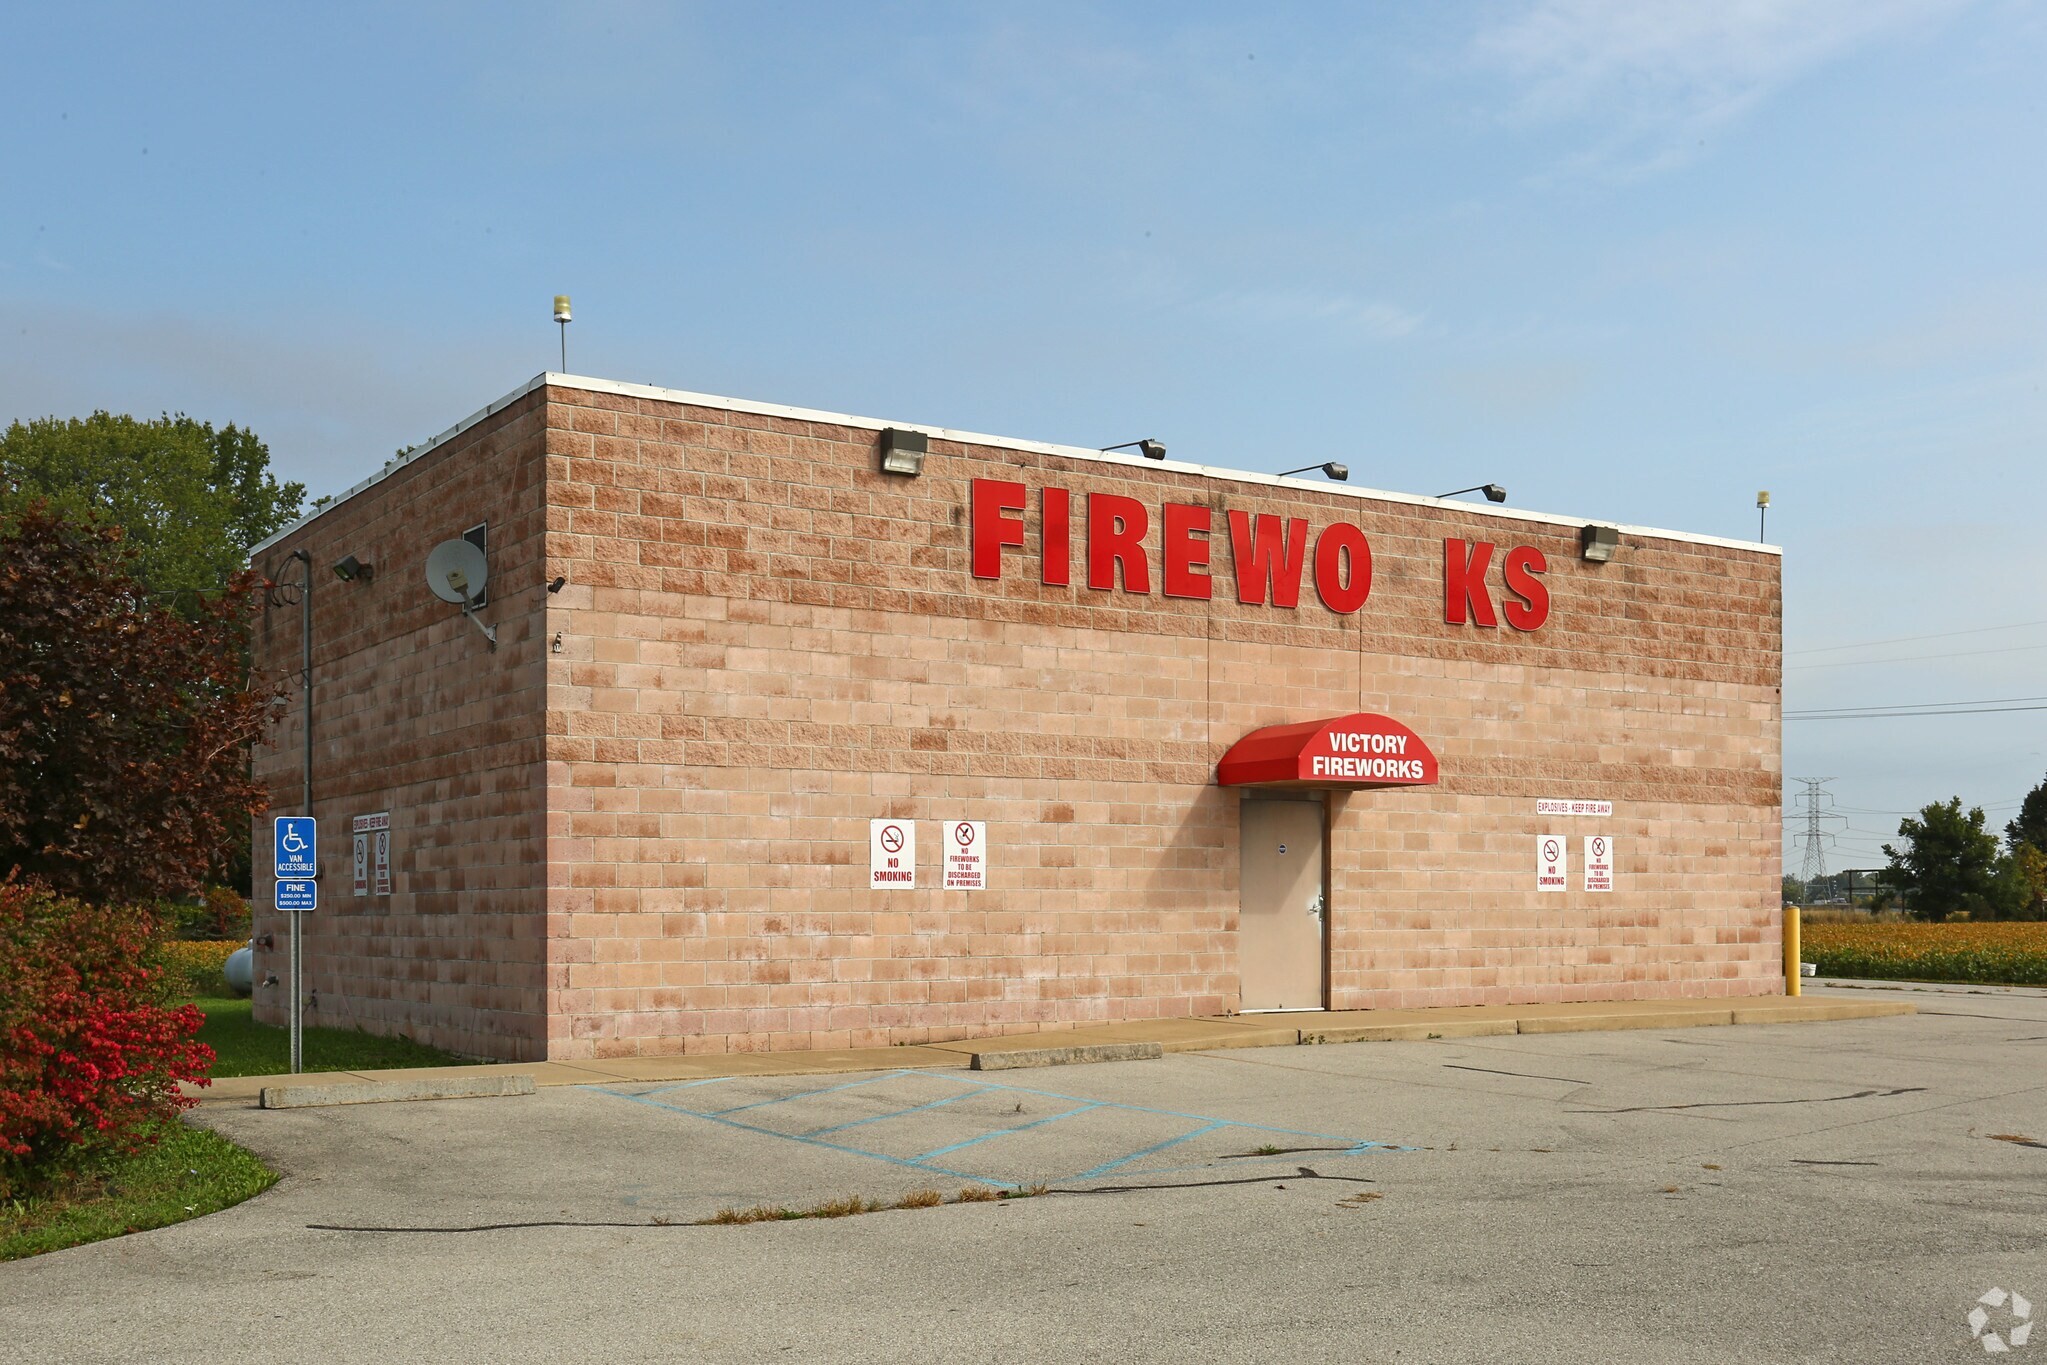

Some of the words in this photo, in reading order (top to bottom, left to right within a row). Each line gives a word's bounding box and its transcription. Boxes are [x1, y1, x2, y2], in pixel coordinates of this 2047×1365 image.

[1329, 732, 1407, 755] VICTORY
[1312, 756, 1424, 779] FIREWORKS
[1538, 802, 1568, 812] EXPLOSIVES
[1571, 803, 1585, 813] KEEP
[1585, 803, 1596, 813] FIRE
[1597, 804, 1611, 813] AWAY
[289, 855, 303, 863] VAN
[887, 858, 899, 868] NO
[278, 863, 314, 872] ACCESSIBLE
[1548, 866, 1556, 874] NO
[874, 871, 912, 881] SMOKING
[948, 871, 981, 879] DISCHARGED
[1539, 877, 1565, 885] SMOKING
[286, 884, 306, 892] FINE
